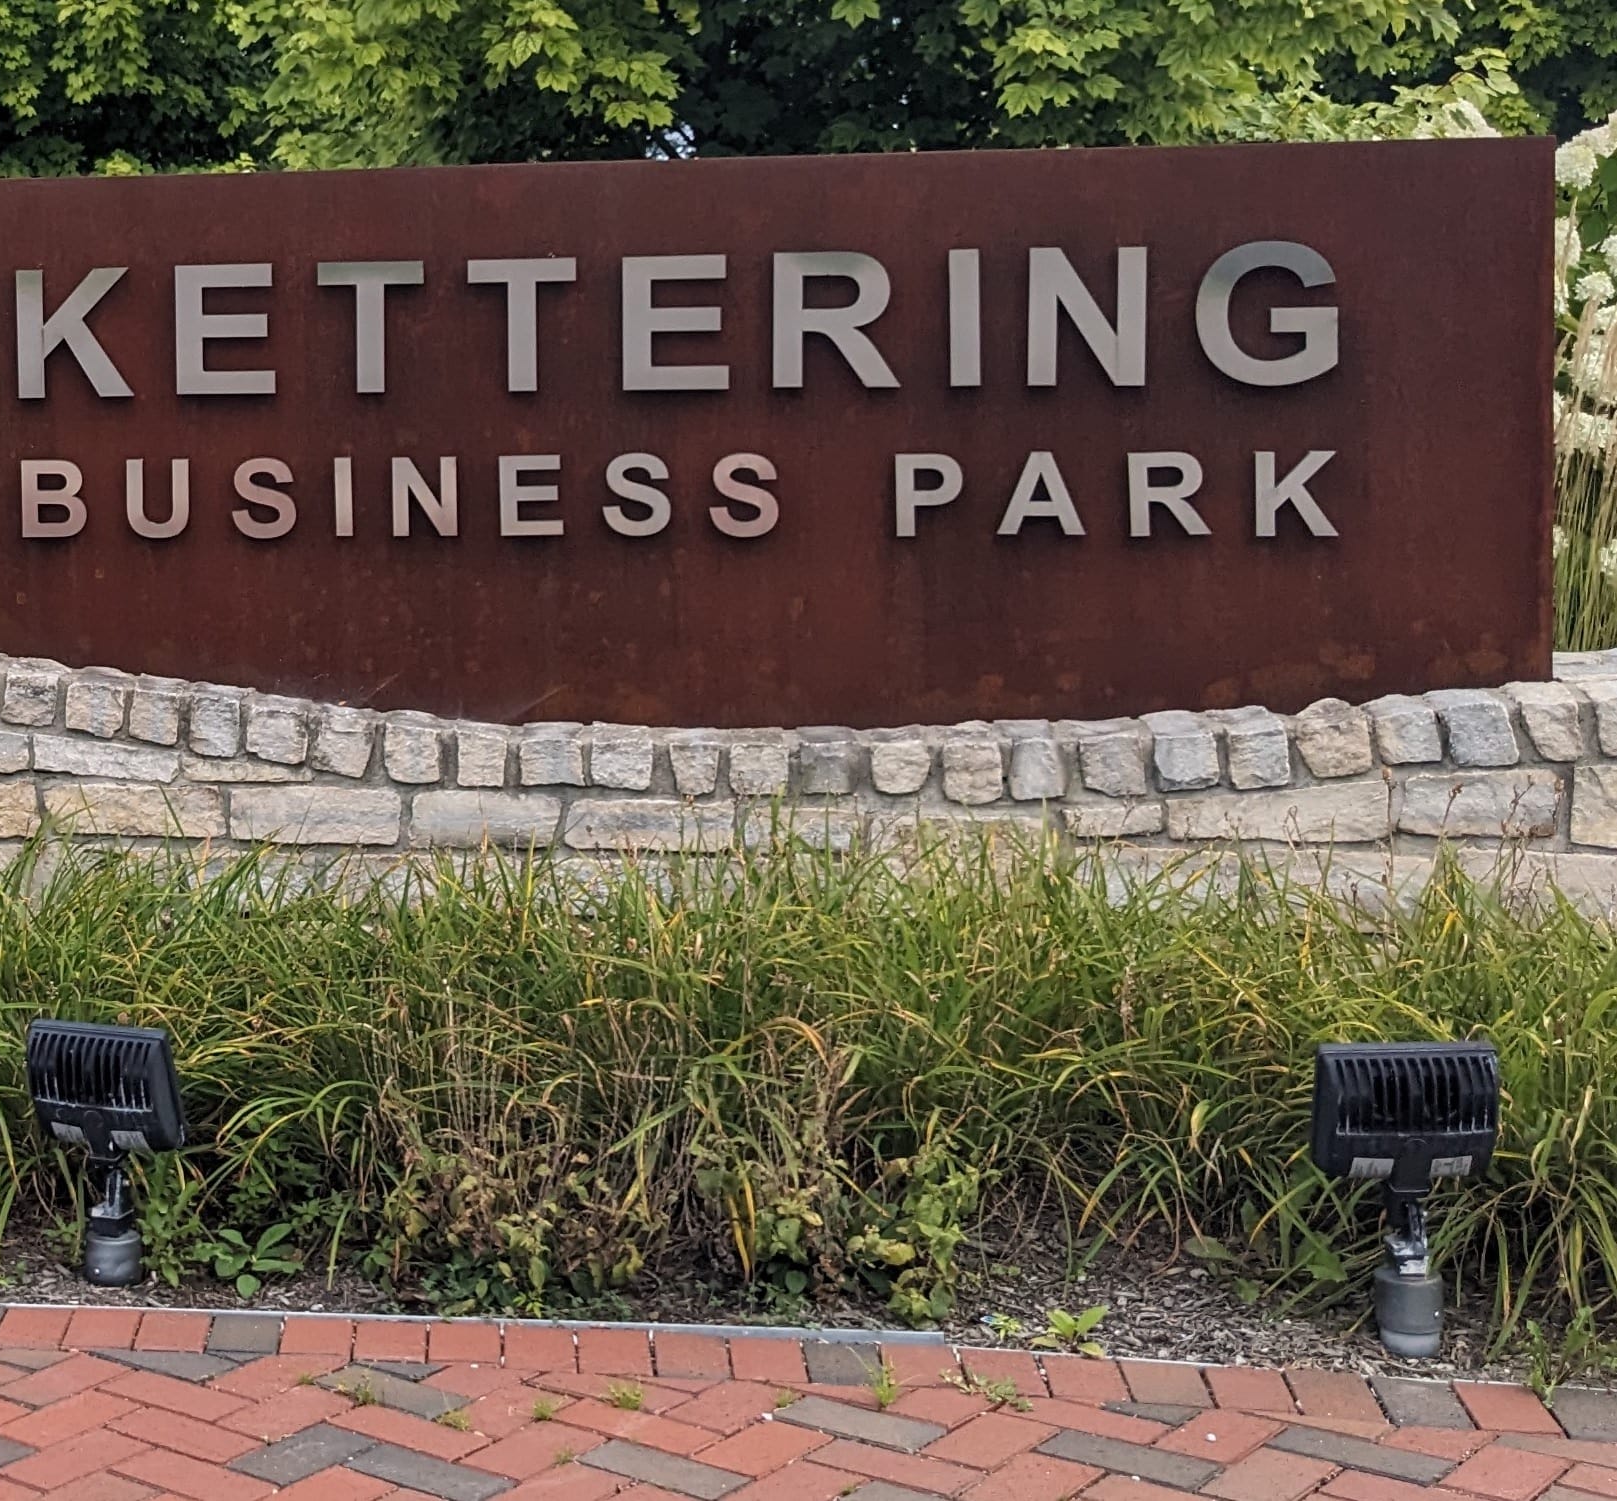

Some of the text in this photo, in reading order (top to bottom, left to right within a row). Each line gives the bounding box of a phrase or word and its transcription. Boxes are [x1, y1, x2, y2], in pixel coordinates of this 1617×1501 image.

[15, 240, 1339, 399] KETTERING
[20, 450, 1339, 539] BUSINESS PARK
